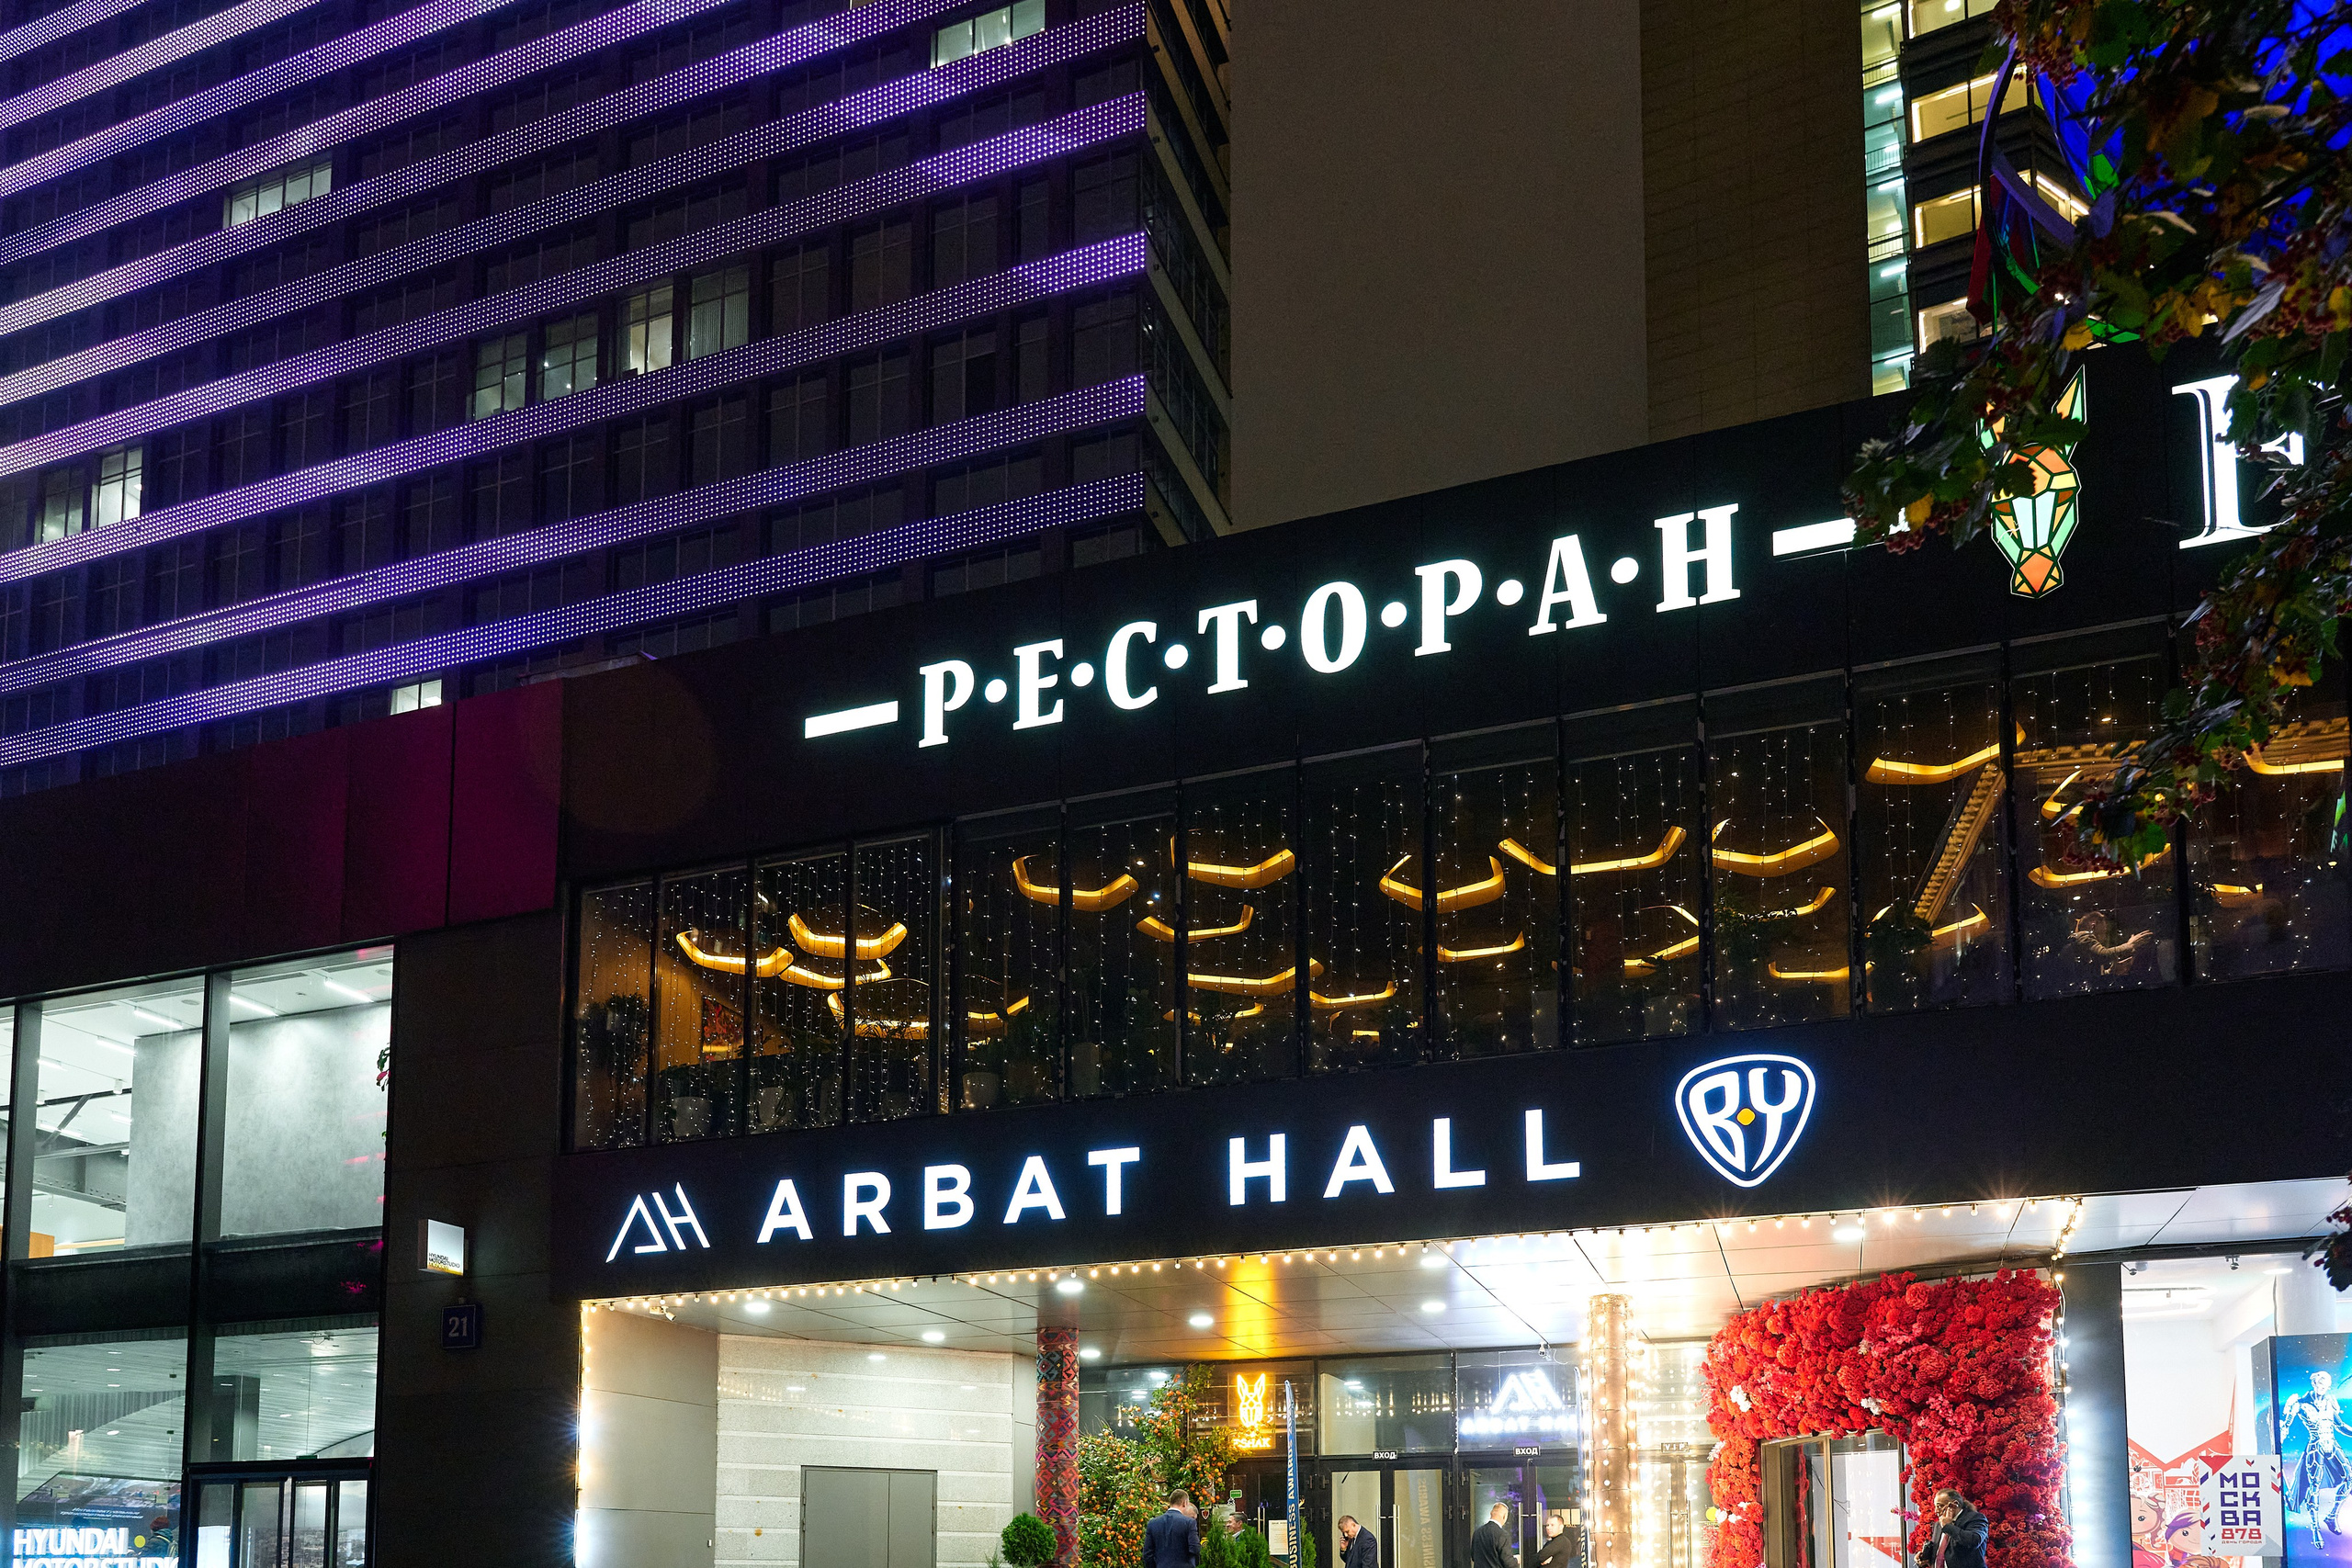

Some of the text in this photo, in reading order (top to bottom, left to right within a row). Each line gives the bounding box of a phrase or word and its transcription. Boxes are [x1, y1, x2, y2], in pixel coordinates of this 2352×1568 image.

[757, 1146, 1140, 1244] ARBAT
[1229, 1109, 1580, 1206] HALL
[448, 1316, 468, 1337] 21
[1665, 1443, 1685, 1451] VIP
[1374, 1451, 1396, 1460] ВХОД
[14, 1527, 129, 1556] HYUNDAI
[2222, 1529, 2261, 1540] 878
